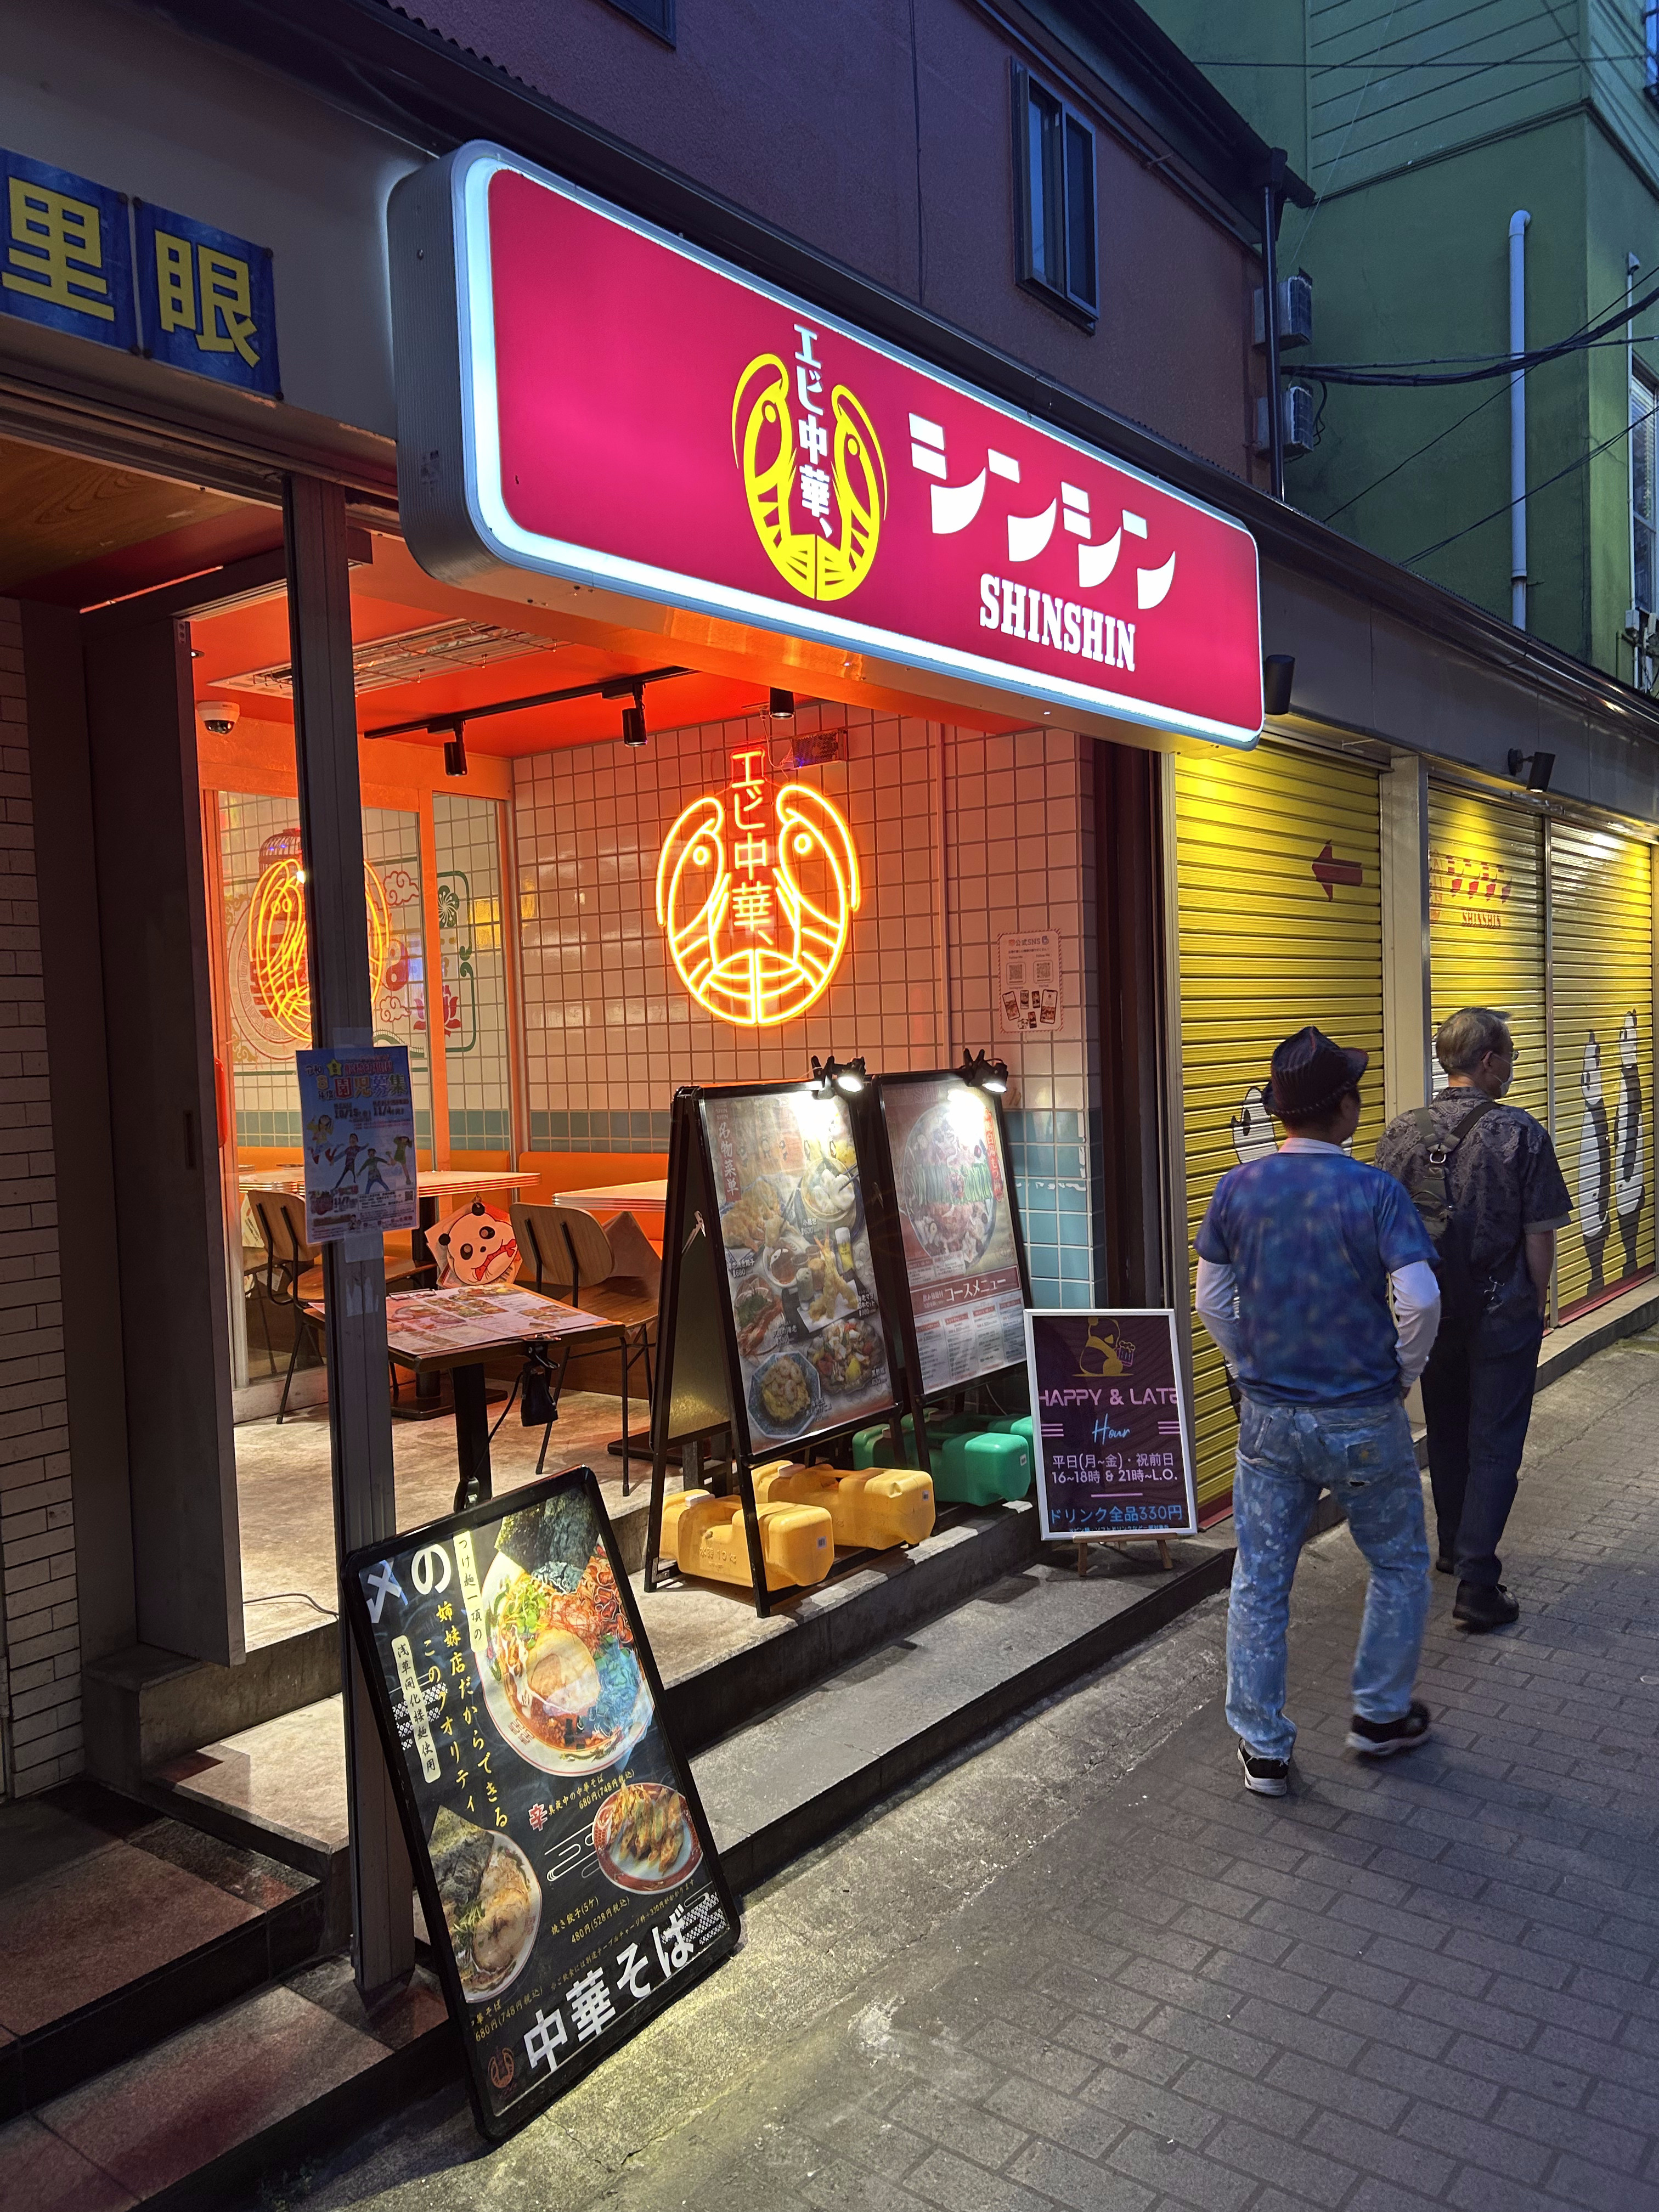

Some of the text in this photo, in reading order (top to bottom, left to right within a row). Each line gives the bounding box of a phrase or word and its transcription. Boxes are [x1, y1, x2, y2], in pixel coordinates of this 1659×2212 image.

[2, 176, 260, 368] 里眼
[909, 412, 1176, 610] シンシン
[979, 572, 1137, 673] SHINSHIN
[1462, 908, 1502, 929] SHINSHIN
[335, 1073, 407, 1099] 園児募集
[945, 1278, 1006, 1302] コースメニュー
[1039, 1387, 1177, 1406] HAPPY & LATE
[1092, 1413, 1130, 1445] Hour
[1049, 1504, 1183, 1524] ドリンク全品330円
[458, 1539, 482, 1640] つけ麺一頂の
[397, 1643, 436, 1774] 浅草開化楼麺使用
[424, 1639, 475, 1813] このクオリティ
[436, 1601, 509, 1828] 姉妹店だからできる
[548, 1772, 605, 1816] 真夜中の中華そば
[571, 1896, 630, 1944] 480円(528円税込)
[523, 1902, 695, 2073] 中華そば
[471, 1998, 502, 2027] 華そば
